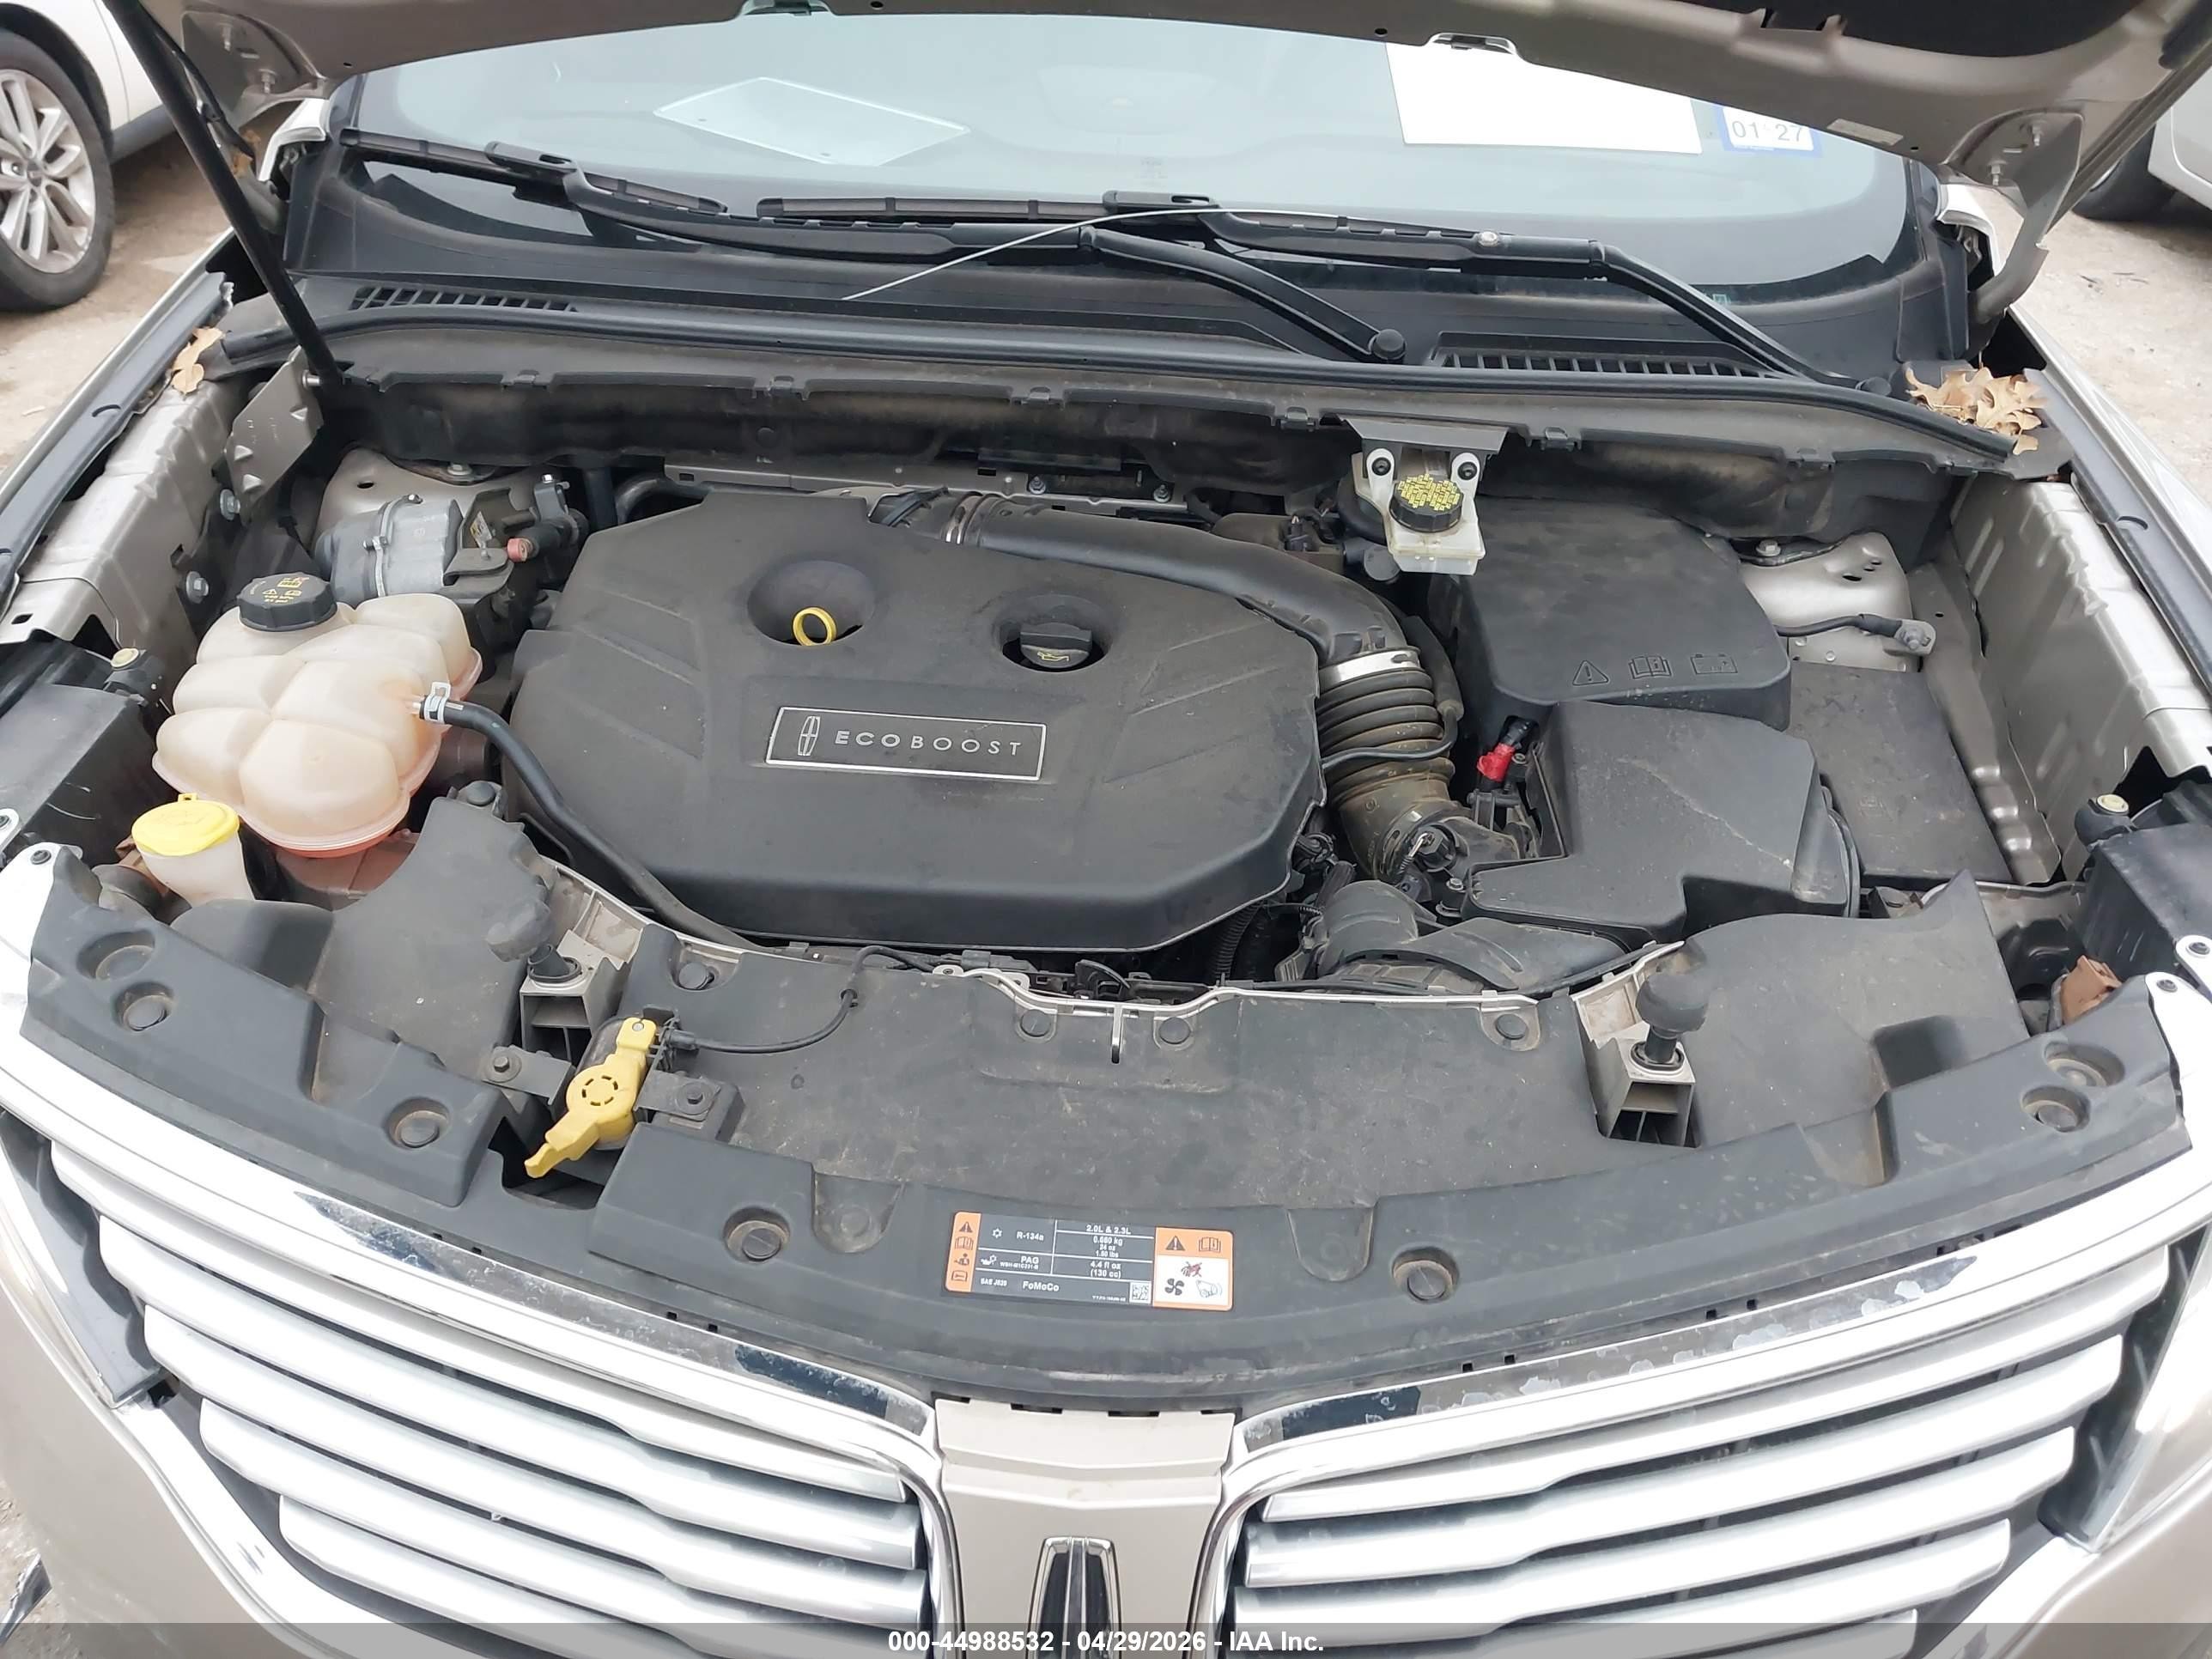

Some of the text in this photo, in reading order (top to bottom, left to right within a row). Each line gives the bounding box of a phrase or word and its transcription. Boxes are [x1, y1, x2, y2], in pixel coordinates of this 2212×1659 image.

[1731, 120, 1802, 142] 01 27
[835, 730, 1021, 756] ECOBOOST
[1086, 1224, 1103, 1233] 2.0L
[1016, 1231, 1045, 1242] R-134a
[1020, 1255, 1040, 1265] PAG
[1090, 1269, 1108, 1278] (130
[1022, 1280, 1060, 1292] FoMoCo
